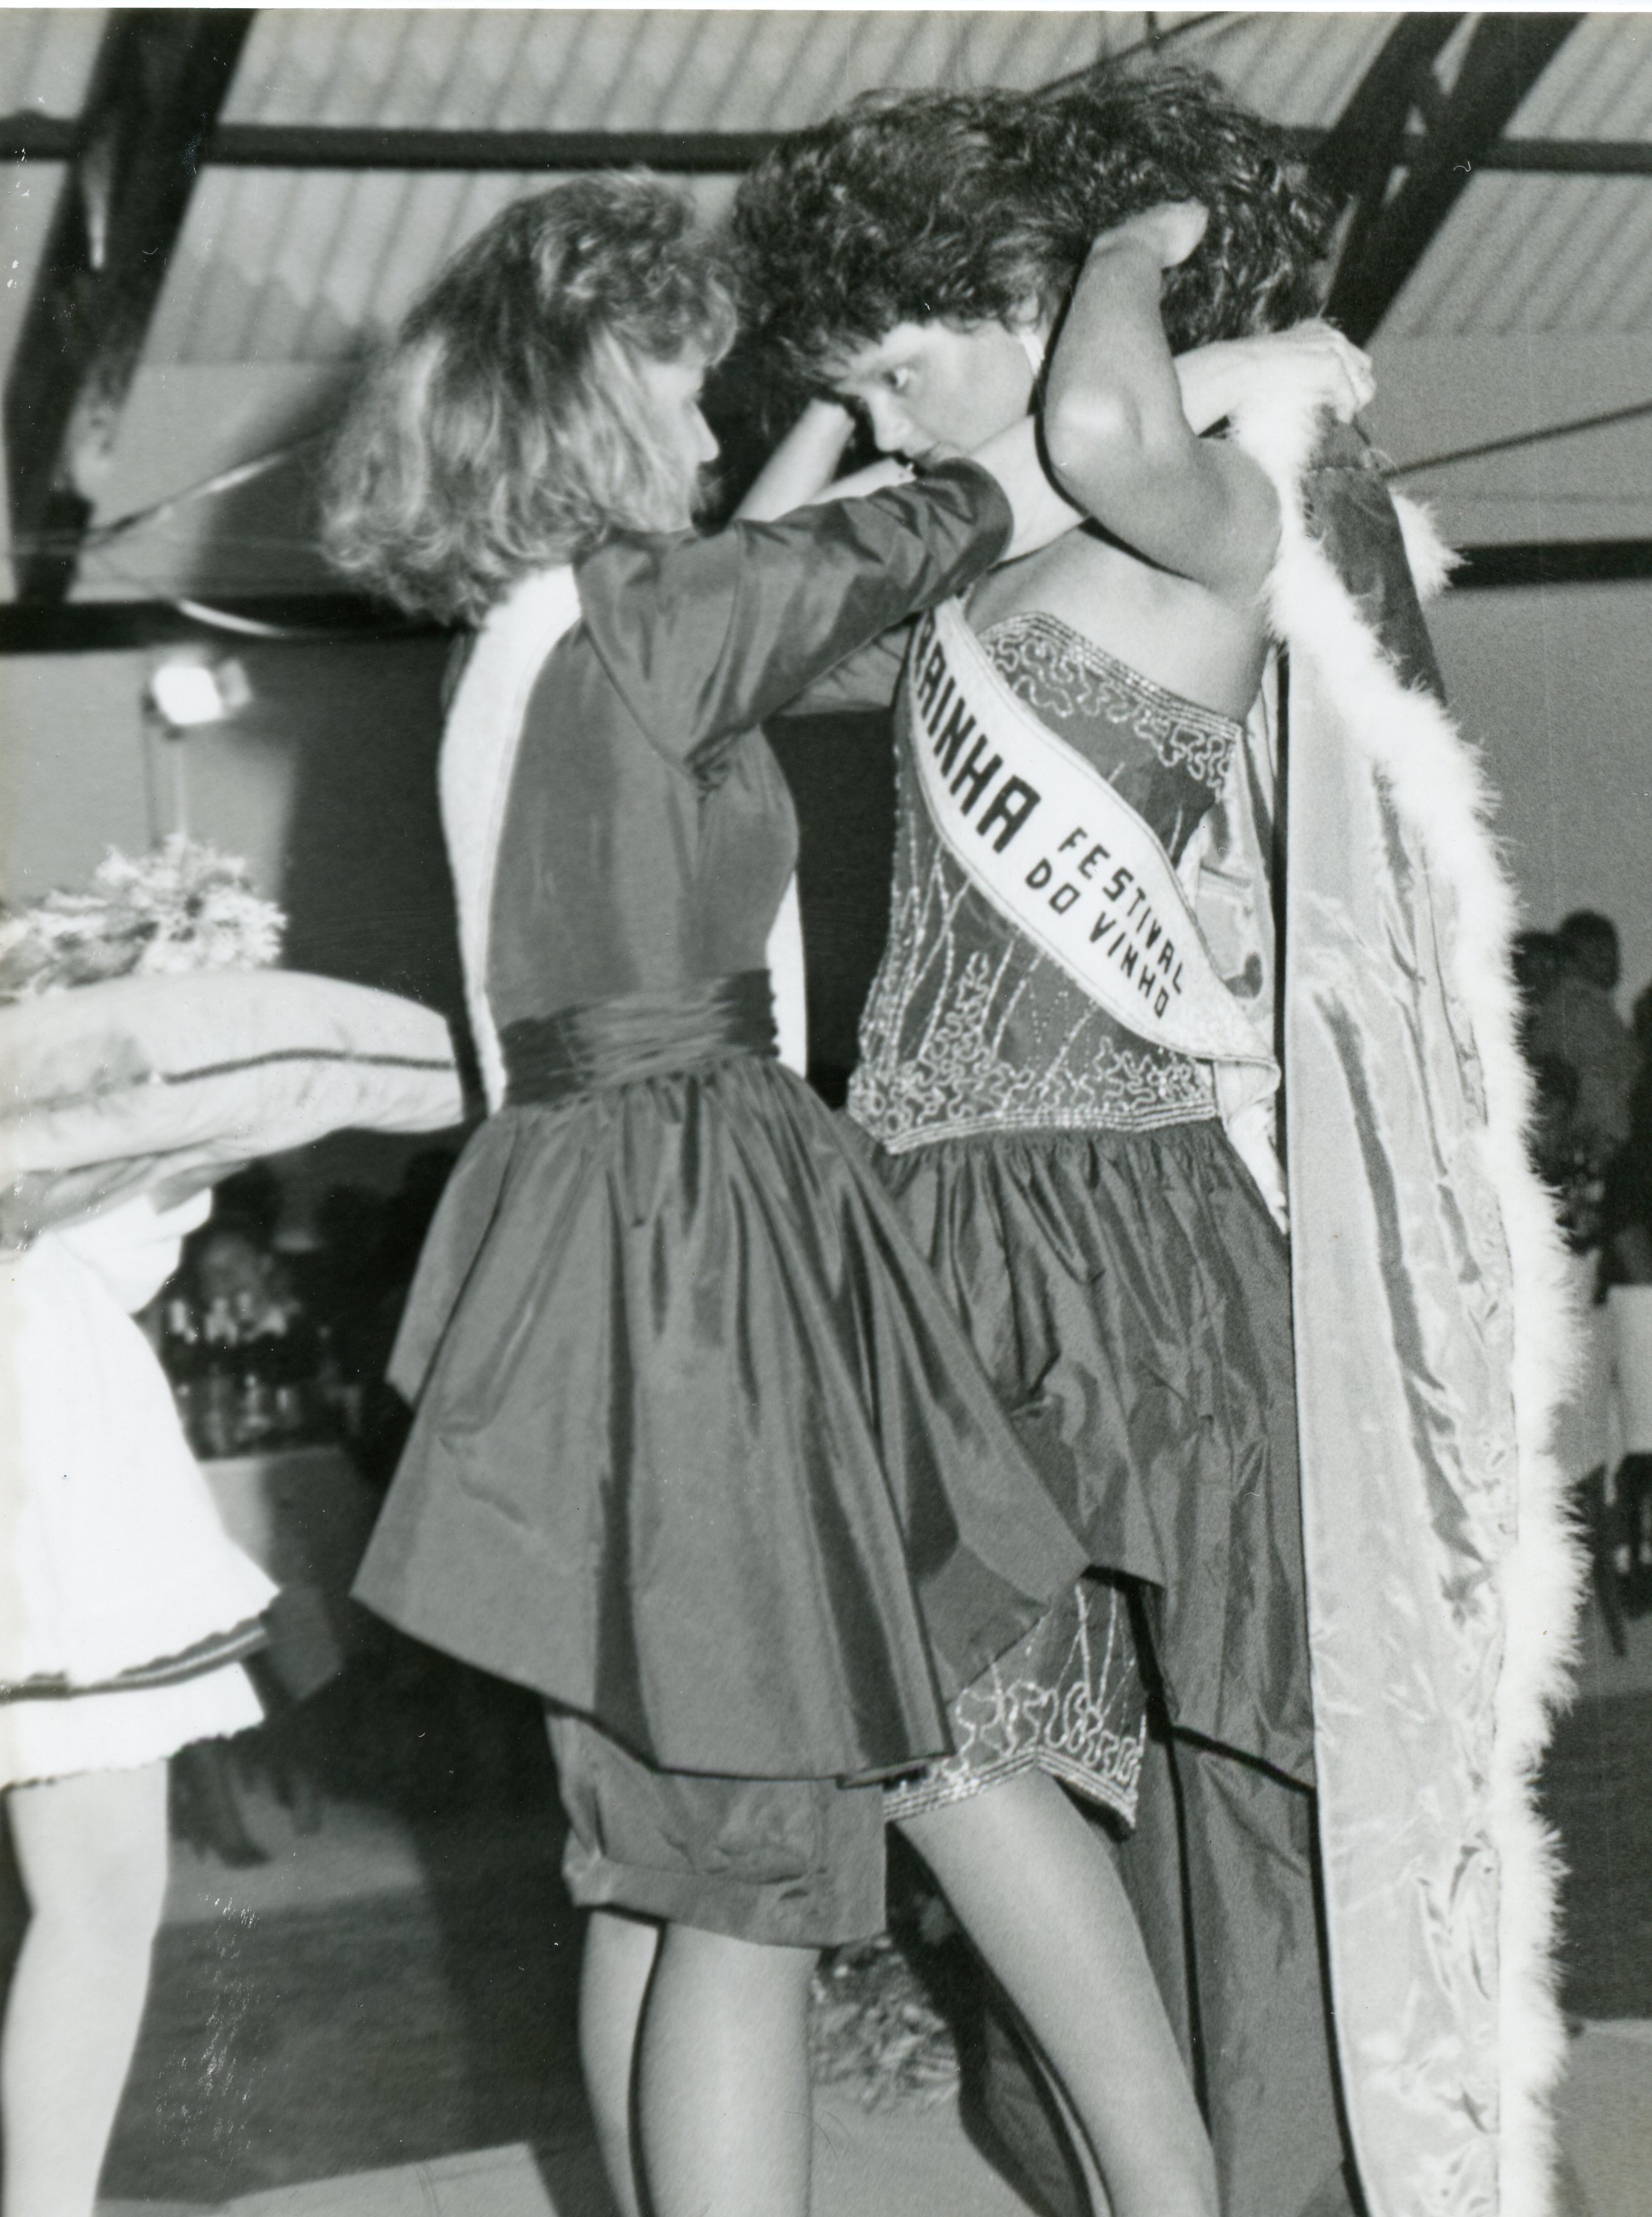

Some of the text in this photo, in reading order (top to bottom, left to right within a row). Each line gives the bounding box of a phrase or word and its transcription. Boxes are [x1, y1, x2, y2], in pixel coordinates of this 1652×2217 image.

[1025, 858, 1170, 1019] DO VINHO
[1058, 826, 1183, 995] FESTIVAL
